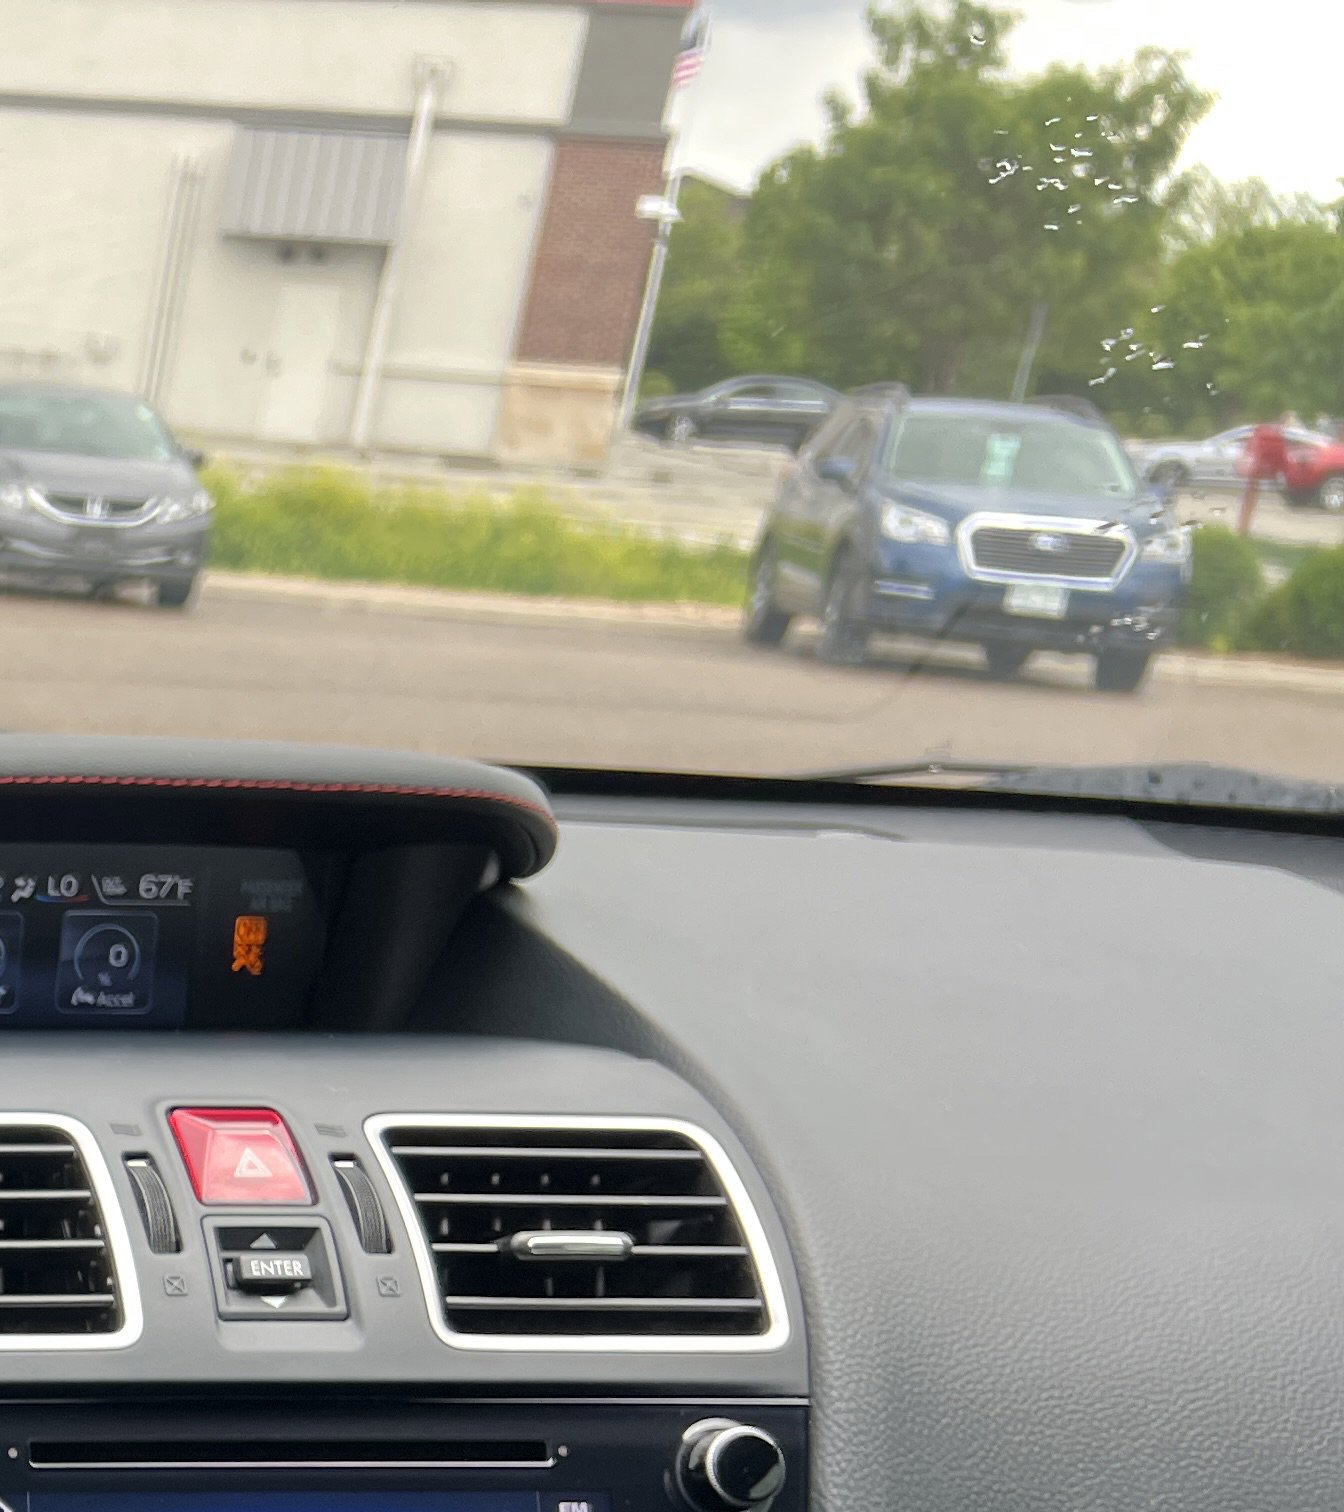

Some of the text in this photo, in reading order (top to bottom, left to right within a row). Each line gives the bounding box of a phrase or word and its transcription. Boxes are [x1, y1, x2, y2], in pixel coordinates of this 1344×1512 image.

[47, 874, 80, 897] LO
[109, 943, 128, 967] 0
[250, 1259, 304, 1277] ENTER
